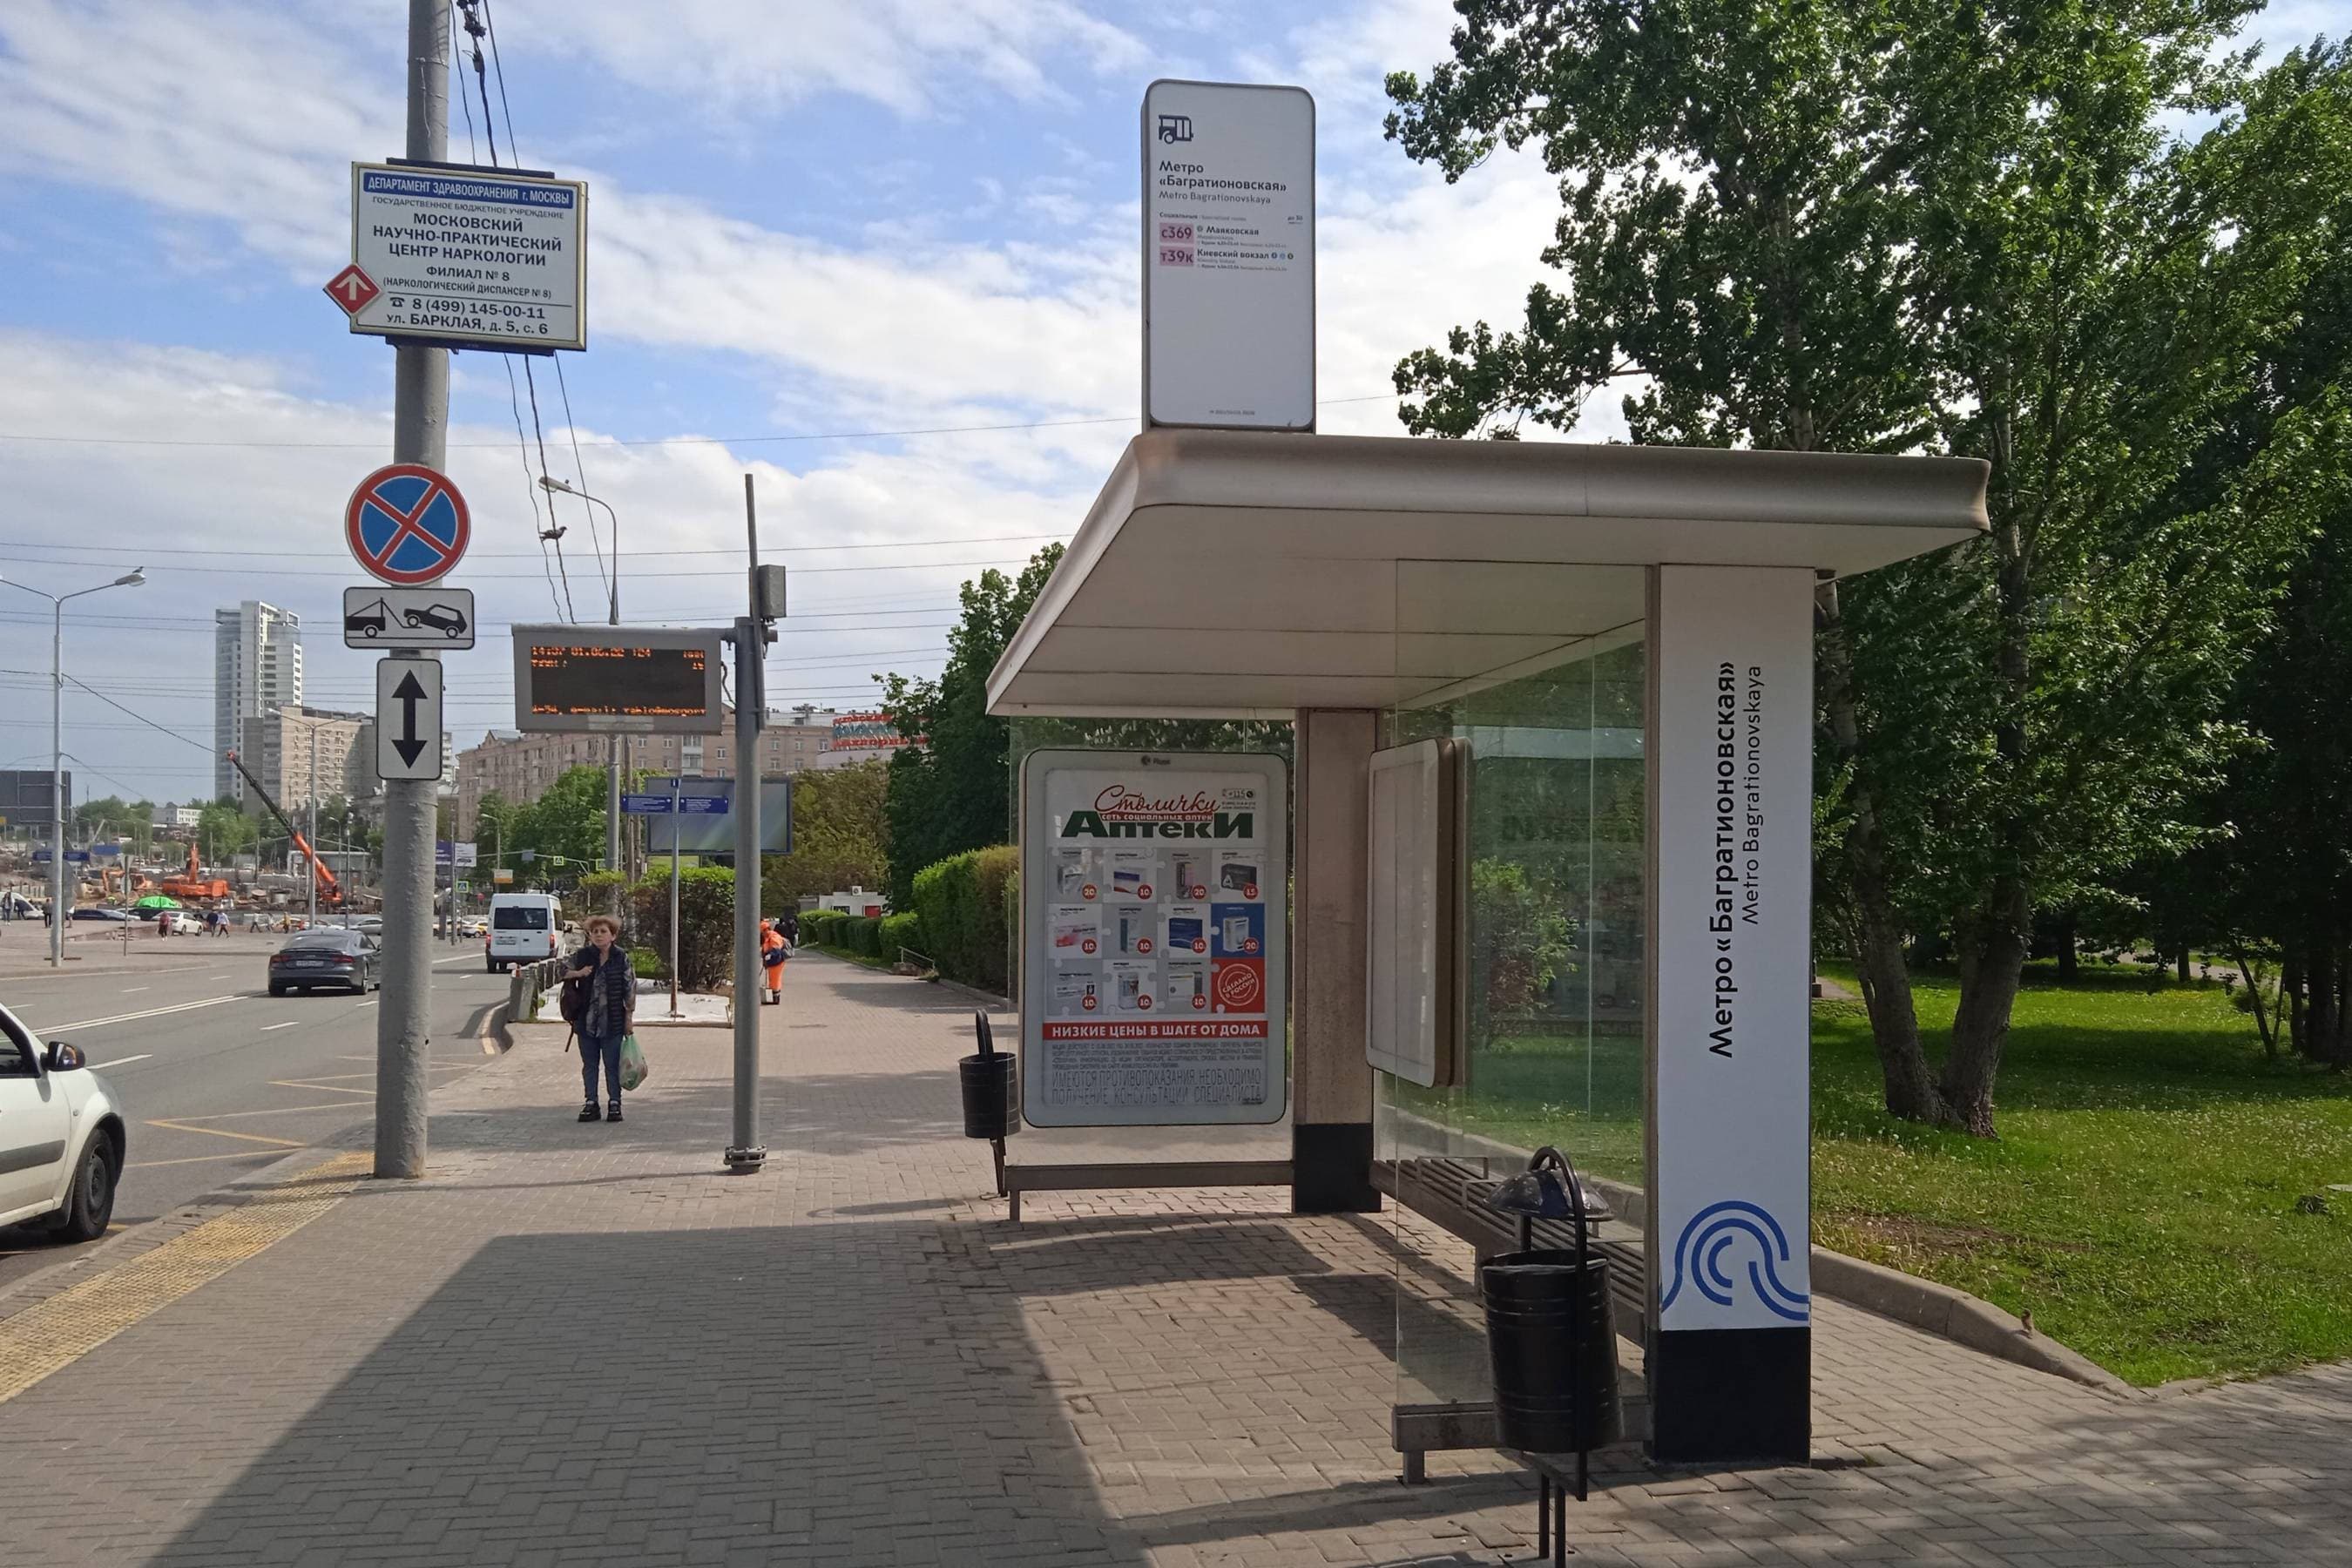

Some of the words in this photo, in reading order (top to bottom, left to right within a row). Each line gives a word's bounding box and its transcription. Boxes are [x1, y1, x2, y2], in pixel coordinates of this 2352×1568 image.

[1159, 160, 1204, 175] Метро
[368, 176, 430, 193] ДЕПАРТАМЕНТ
[433, 182, 518, 200] ЗДРАВООХРАНЕНИЯ
[530, 191, 570, 205] МОСКВЫ
[1159, 175, 1287, 192] «Багратионовская»
[372, 196, 452, 210] ГОСУДАРСТВЕННОЕ
[455, 202, 508, 214] БЮДЖЕТНОЕ
[509, 207, 564, 220] УЧРЕЖДЕНИЕ
[1159, 191, 1187, 200] Metro
[1190, 192, 1271, 205] Bagrationovskaya
[413, 213, 523, 232] МОСКОВСКИЙ
[1206, 226, 1259, 236] Маяковская
[373, 226, 562, 252] НАУЧНО-ПРАКТИЧЕСКИЙ
[389, 242, 438, 259] ЦЕНТР
[443, 247, 546, 267] НАРКОЛОГИИ
[1197, 249, 1238, 259] Киевский
[1240, 251, 1269, 260] вокзал
[426, 266, 482, 280] ФИЛИАЛ
[485, 269, 498, 280] №
[502, 271, 510, 281] 8
[382, 276, 476, 294] (НАРКОЛОГИЧЕСКИЙ
[476, 283, 531, 297] ДИСПАНСЕР
[542, 288, 551, 300] 8)
[412, 297, 422, 310] 8
[426, 299, 466, 314] (499)
[469, 305, 545, 320] 145-00-11
[410, 313, 486, 333] БАРКЛАЯ,
[489, 321, 502, 333] д.
[505, 322, 519, 335] 5,
[538, 323, 549, 335] 6
[1742, 666, 1764, 853] Bagrationovskaya
[1094, 785, 1221, 813] Столички
[1124, 814, 1183, 822] социальных
[1742, 859, 1759, 925] Metro
[1710, 957, 1737, 1058] Метро
[1052, 1025, 1105, 1037] НИЗКИЕ
[1109, 1025, 1146, 1037] ЦЕНЫ
[1151, 1025, 1158, 1036] В
[1162, 1024, 1197, 1036] ШАГЕ
[1200, 1024, 1217, 1036] ОТ
[1220, 1024, 1260, 1037] ДОМА
[1052, 1071, 1097, 1087] ИМЕЮТСЯ
[1200, 1069, 1261, 1086] НЕОБХОДИМО
[1052, 1088, 1109, 1105] ПОЛУЧЕНИЕ
[1115, 1087, 1187, 1104] КОНСУЛЬТАЦИИ
